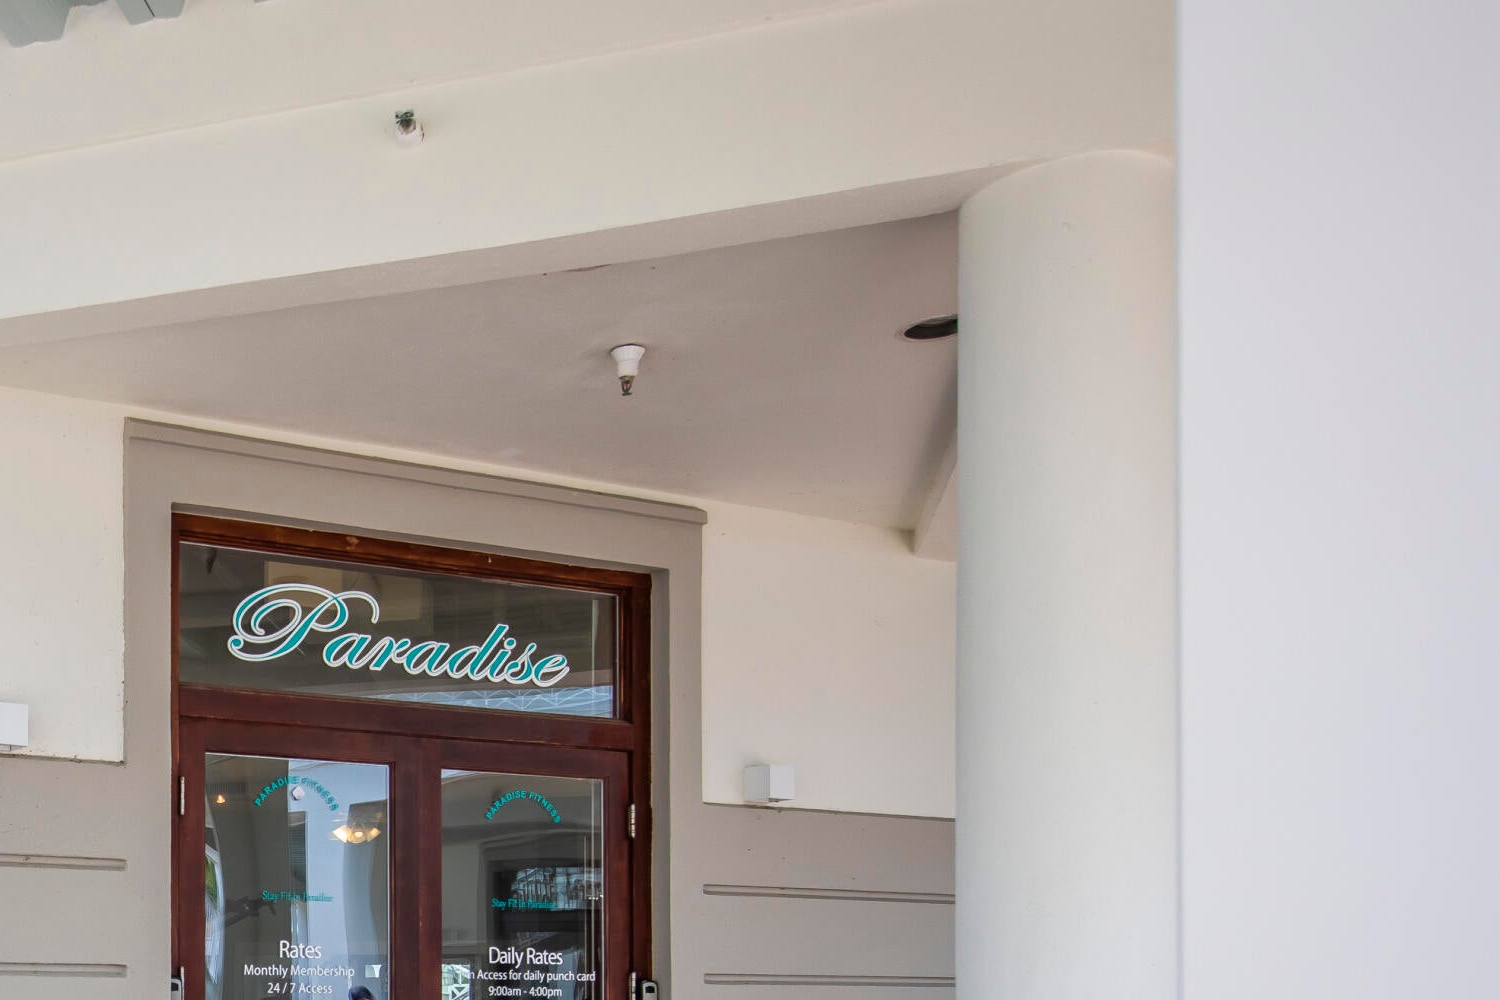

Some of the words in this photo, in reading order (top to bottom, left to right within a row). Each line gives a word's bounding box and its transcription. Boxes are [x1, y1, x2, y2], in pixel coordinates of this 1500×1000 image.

[227, 583, 569, 687] Paradise
[253, 775, 300, 807] PARADISE
[486, 789, 526, 820] PARADISE
[528, 791, 562, 823] FITNESS
[279, 940, 322, 959] Rates
[488, 946, 524, 969] Daily
[526, 947, 563, 965] Rates
[243, 964, 288, 979] Monthly
[290, 964, 355, 979] Membership
[476, 969, 508, 980] Access
[509, 969, 521, 980] for
[523, 970, 545, 983] daily
[546, 971, 575, 983] punch
[576, 971, 596, 981] card
[267, 982, 280, 994] 24
[298, 982, 333, 994] Access
[488, 985, 522, 997] 9:00am
[529, 986, 563, 999] 4:00pm
